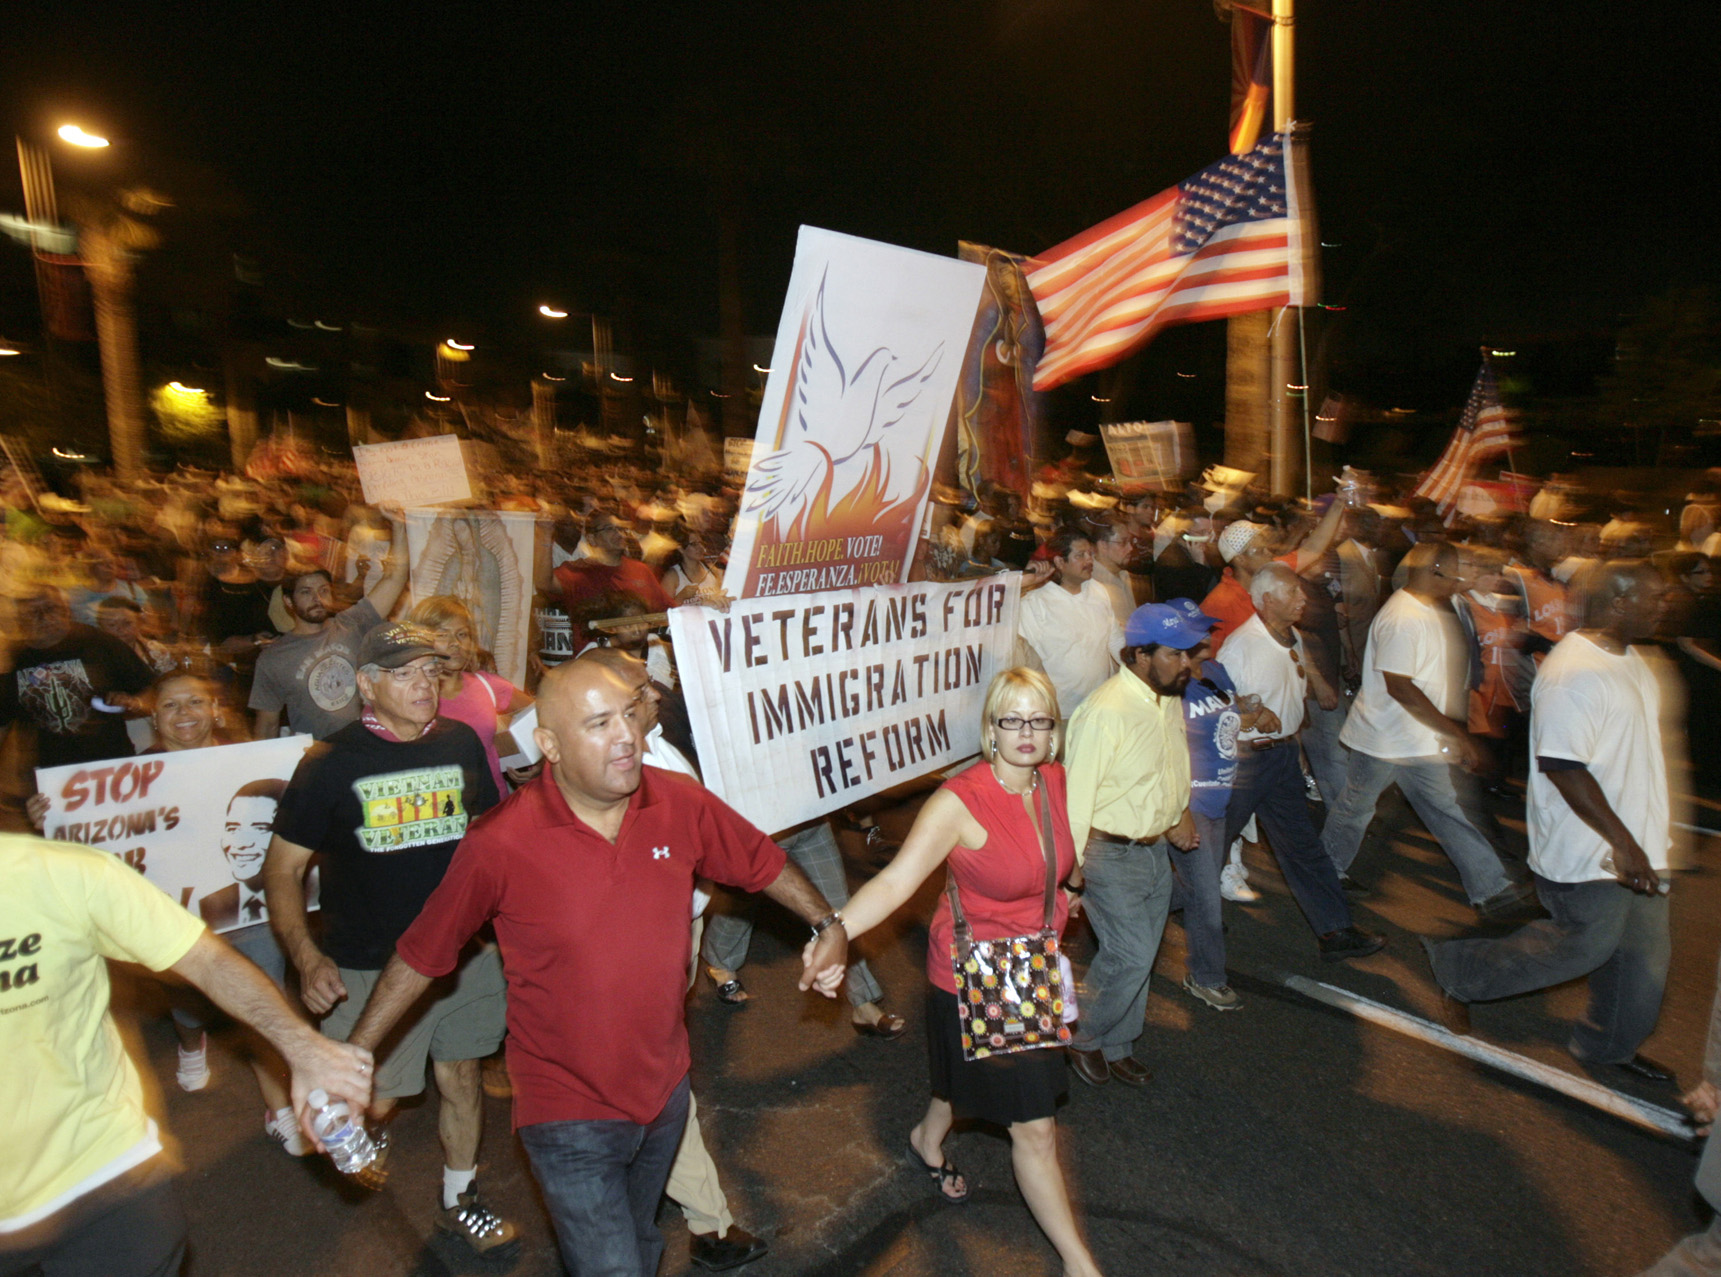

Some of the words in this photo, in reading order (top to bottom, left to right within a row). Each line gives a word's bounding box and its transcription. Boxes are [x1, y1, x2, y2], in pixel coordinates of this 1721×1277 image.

[846, 535, 884, 558] VOTE!
[708, 592, 927, 672] VETERANS
[943, 583, 1006, 632] FOR
[747, 643, 983, 744] IMMIGRATION
[810, 709, 951, 799] REFORM
[61, 760, 164, 812] STOP
[358, 770, 460, 799] VIETNAM
[53, 806, 180, 844] ARIZONA'S
